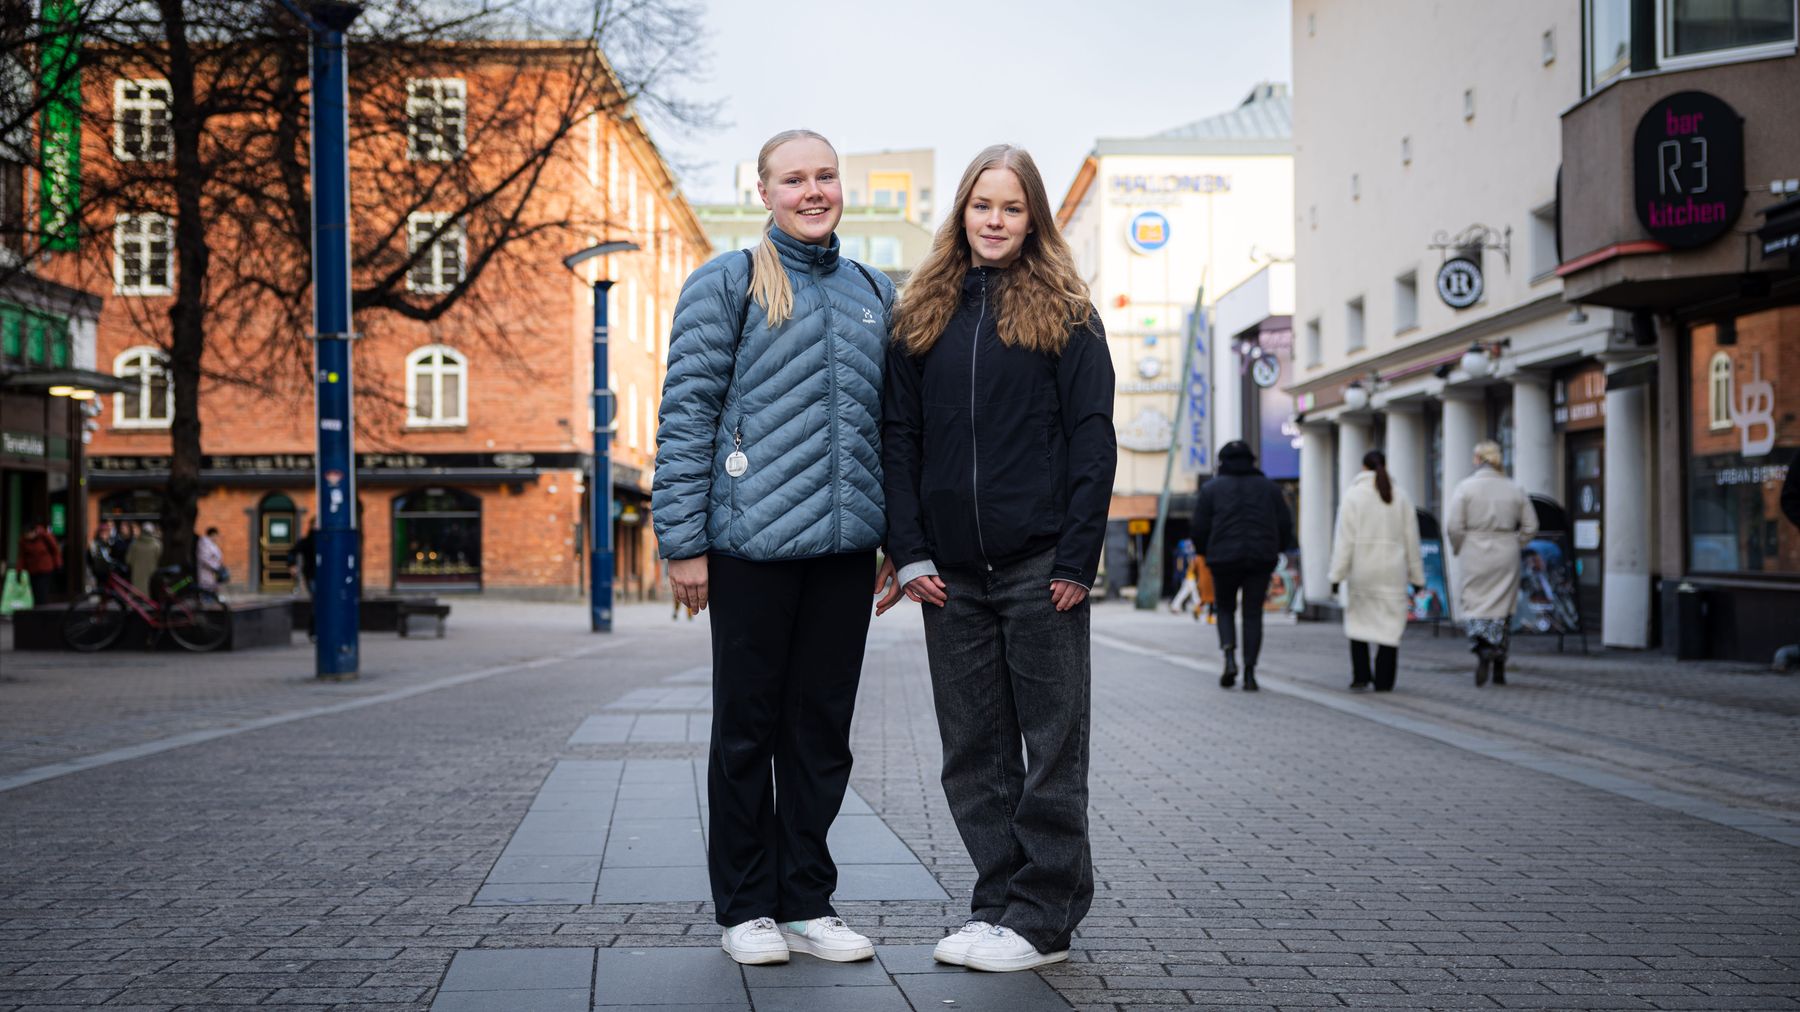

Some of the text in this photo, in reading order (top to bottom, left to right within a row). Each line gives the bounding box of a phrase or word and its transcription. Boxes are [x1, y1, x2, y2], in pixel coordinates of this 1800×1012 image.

[1666, 106, 1704, 136] bar
[1658, 136, 1708, 195] R3
[1110, 174, 1231, 193] HALONEN
[1648, 197, 1726, 228] kitchen
[211, 455, 318, 474] Englis
[363, 455, 427, 468] Pub
